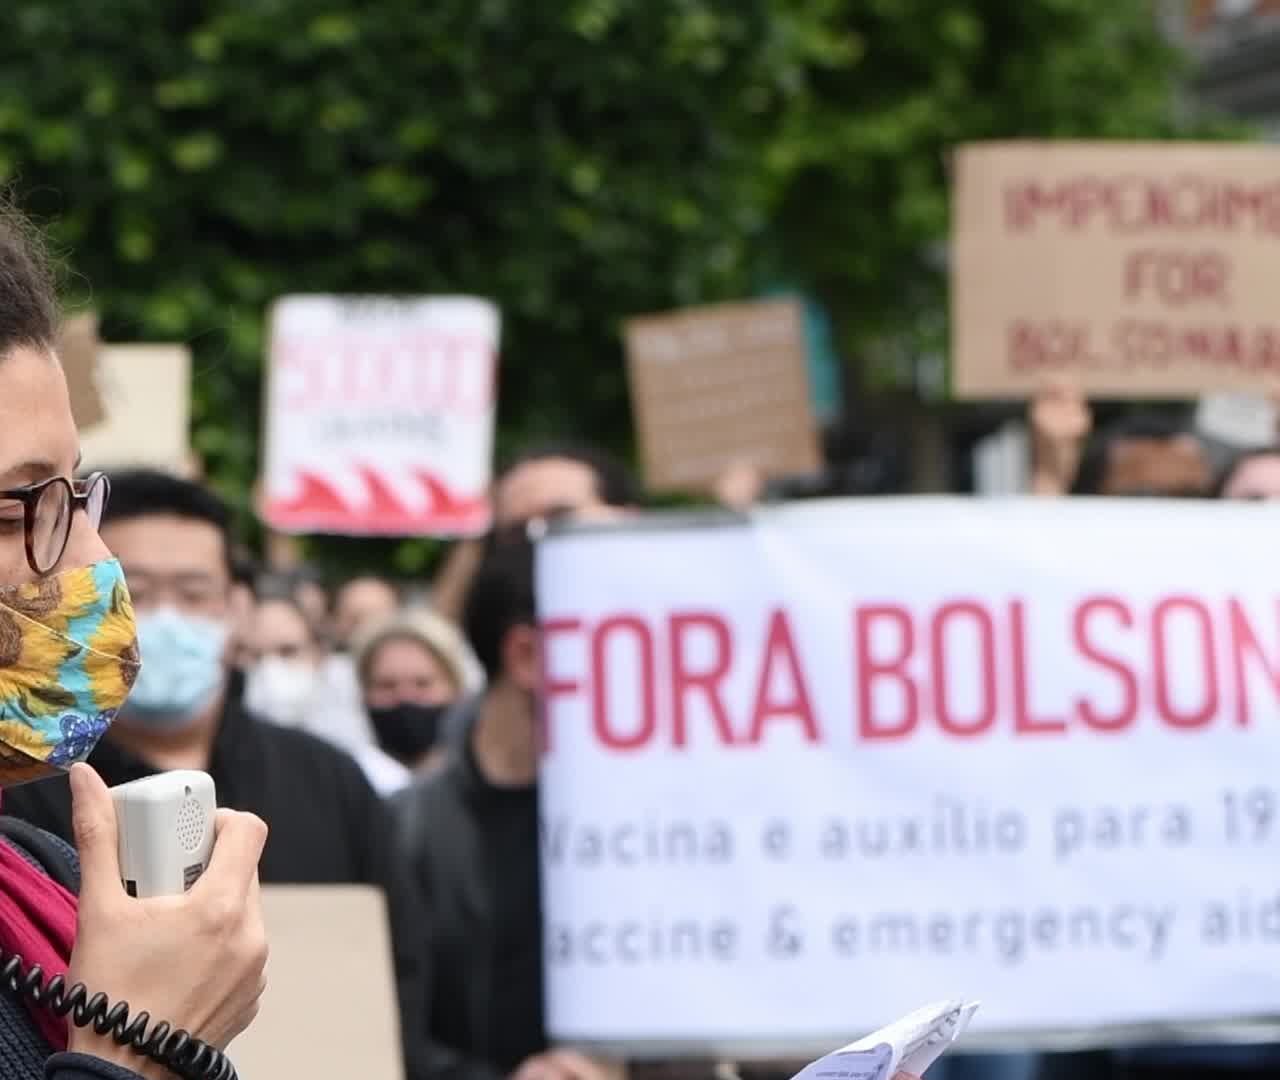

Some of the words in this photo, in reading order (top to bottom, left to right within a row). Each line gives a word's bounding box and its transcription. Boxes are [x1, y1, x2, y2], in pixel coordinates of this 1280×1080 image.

[1122, 248, 1234, 308] FOR
[541, 607, 824, 757] FORA
[853, 594, 1280, 745] BOLSON
[760, 822, 794, 863] e
[1052, 803, 1194, 862] para
[763, 904, 803, 962] &
[829, 908, 1176, 966] emergency
